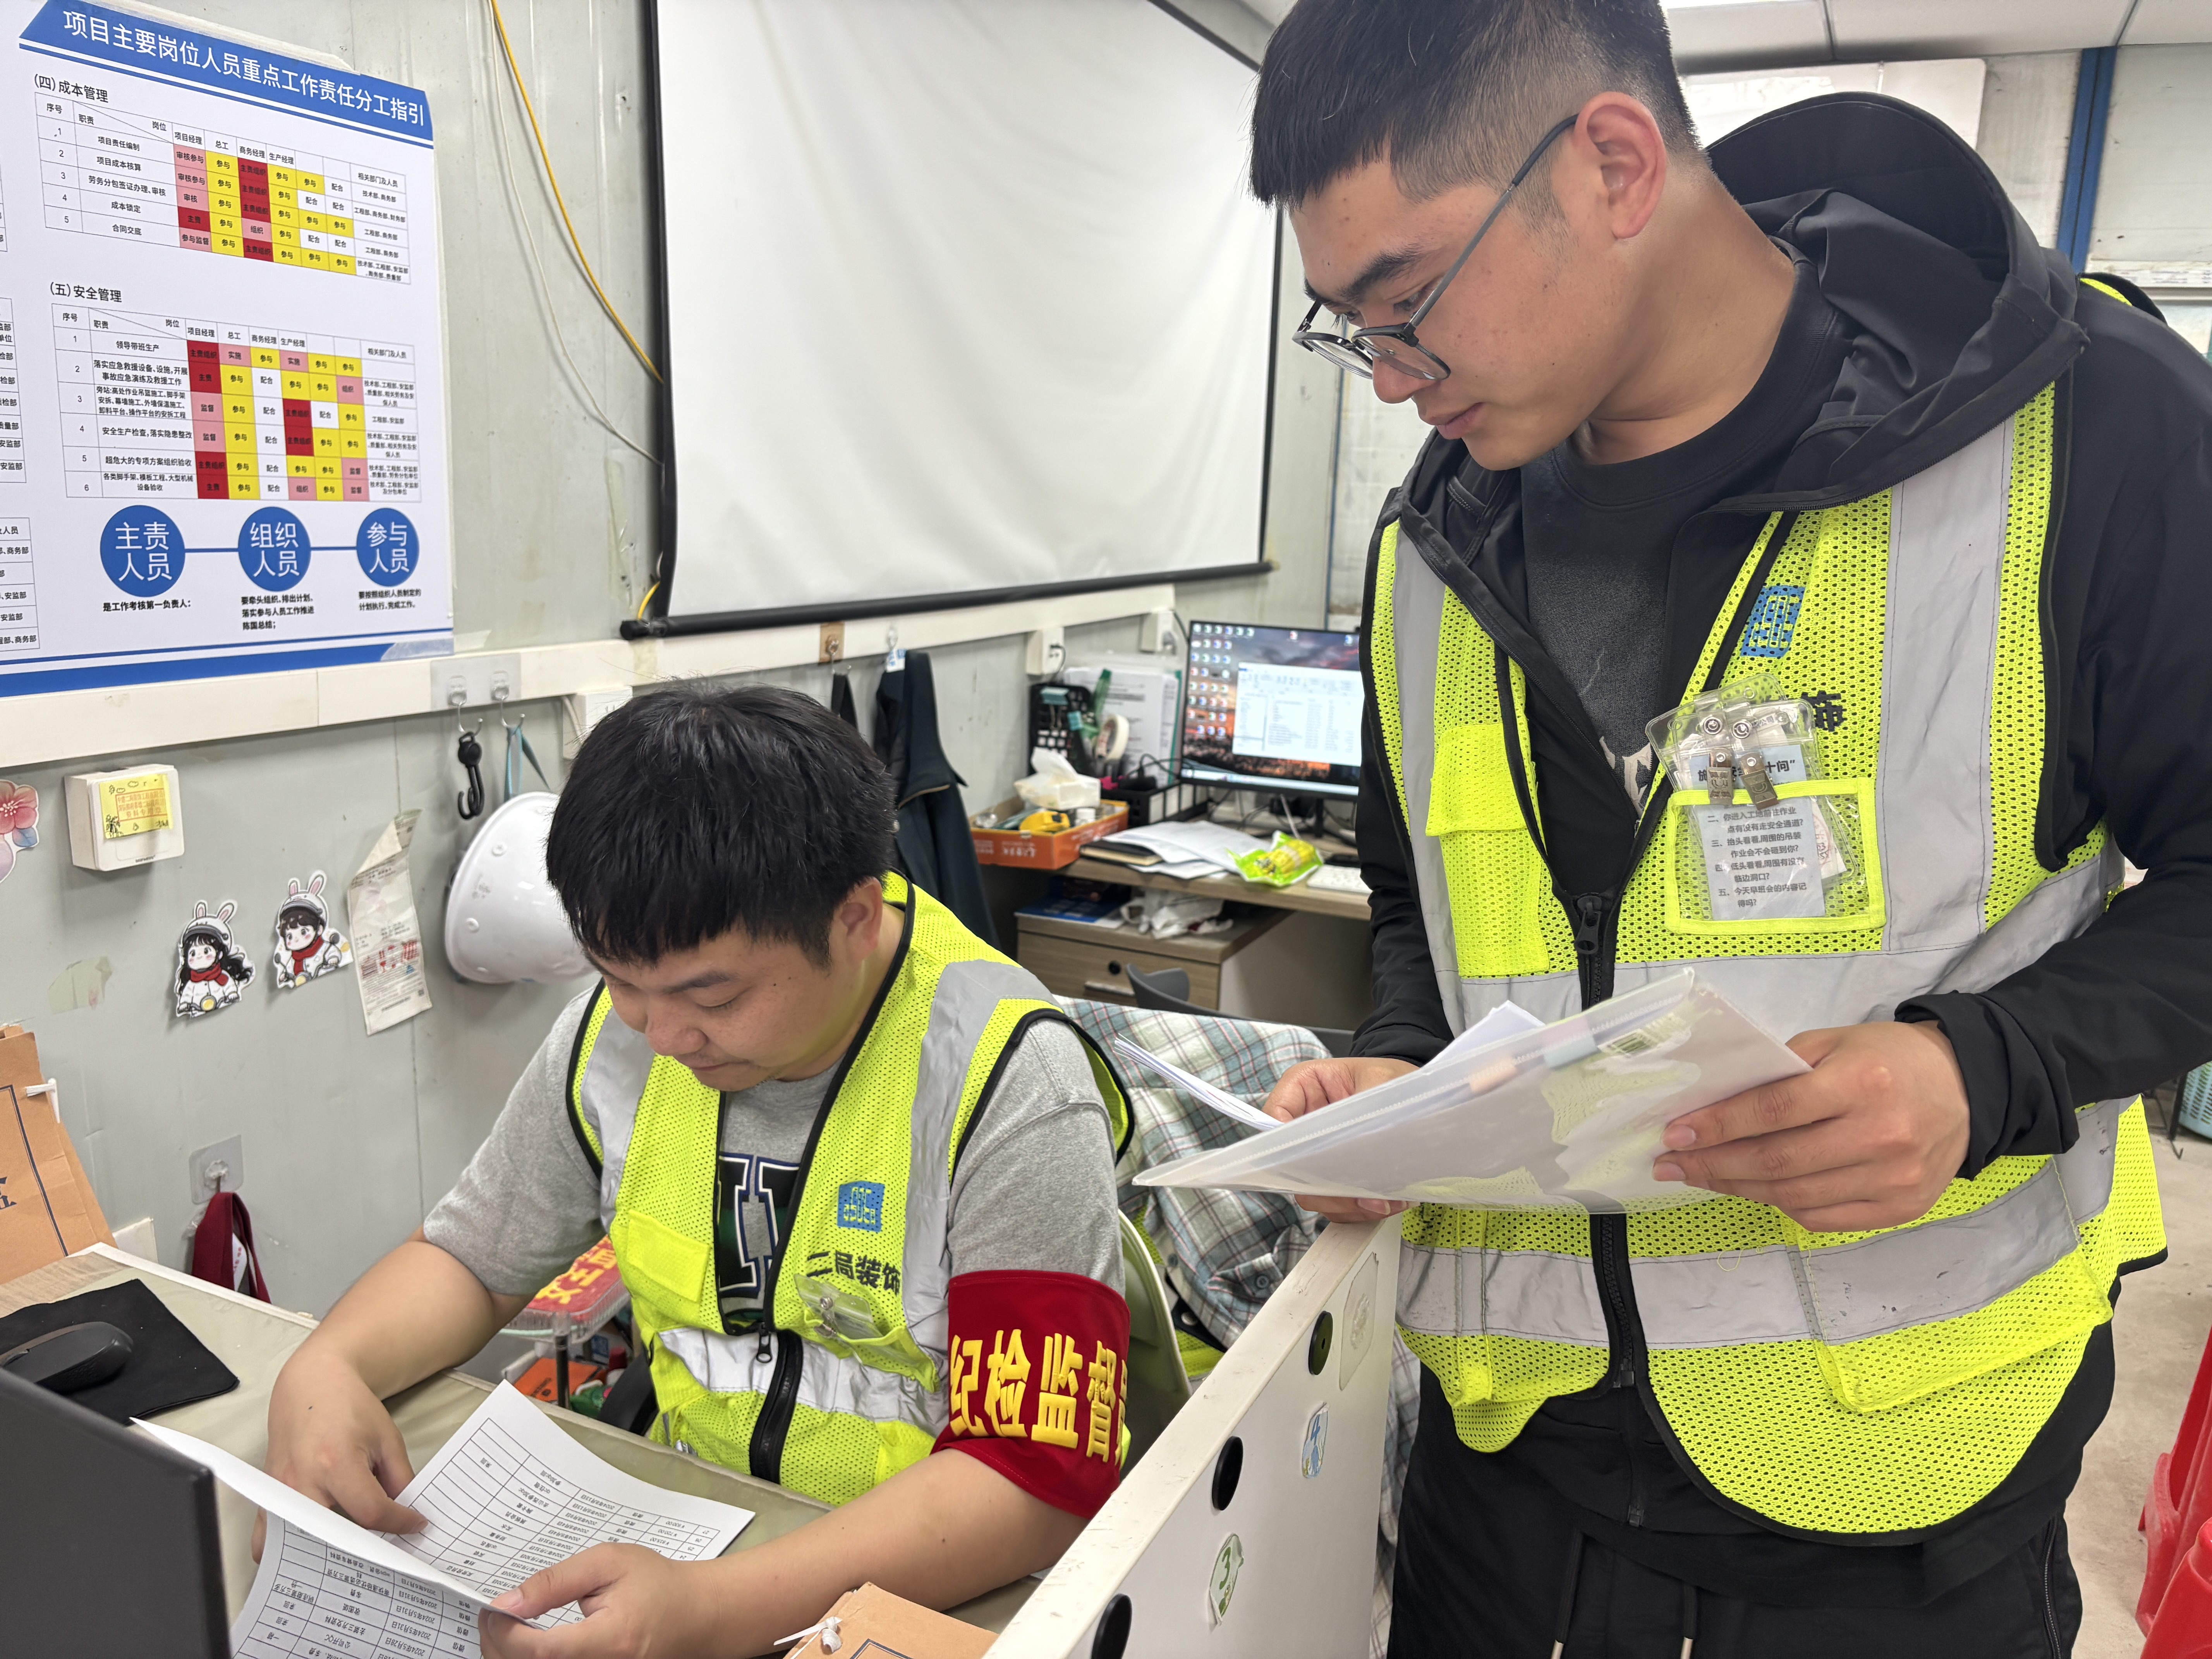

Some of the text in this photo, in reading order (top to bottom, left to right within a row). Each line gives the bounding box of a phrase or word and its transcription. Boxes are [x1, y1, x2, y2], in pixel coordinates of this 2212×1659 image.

[63, 10, 424, 126] 项目主要岗位人员重点工作责任分工指引
[46, 103, 62, 113] 序号
[79, 114, 94, 125] 职责
[152, 121, 167, 131] 岗位
[98, 136, 140, 151] 项目责任编制
[174, 132, 202, 144] 项目经理
[215, 141, 229, 149] 总工
[176, 152, 204, 163] 审核参与
[239, 146, 265, 159] 商务经理
[96, 156, 141, 171] 项目成本核算
[216, 160, 230, 169] 参与
[269, 153, 294, 165] 生产经理
[178, 173, 205, 185] 审核参与
[276, 172, 289, 181] 参与
[88, 175, 166, 196] 劳务分包签证办理、审核
[218, 179, 231, 188] 参与
[184, 194, 198, 203] 审核
[278, 191, 290, 199] 参与
[111, 201, 141, 213] 成本锁定
[218, 199, 231, 208] 参与
[278, 210, 291, 219] 参与
[220, 219, 233, 228] 参与
[112, 224, 142, 235] 合同交底
[280, 230, 292, 239] 参与
[182, 234, 209, 246] 参与监督
[222, 239, 235, 248] 参与
[282, 251, 294, 259] 参与
[63, 313, 77, 322] 序号
[93, 320, 109, 329] 职责
[165, 319, 180, 328] 岗位
[187, 327, 215, 337] 项目经理
[228, 331, 241, 340] 总工
[251, 335, 277, 345] 商务经理
[281, 338, 306, 348] 生产经理
[116, 341, 159, 352] 领导带班生产
[102, 372, 182, 386] 事故应急演练及救援工作
[105, 456, 192, 467] 超危大的专项方案组织验收
[115, 522, 169, 550] 主责
[250, 522, 299, 548] 组织
[367, 522, 407, 547] 参与
[118, 552, 172, 581] 人员
[253, 550, 300, 577] 人员
[369, 548, 410, 574] 人员
[807, 1249, 902, 1297] 二局装饰
[399, 1590, 437, 1609] 2024年5月31日
[396, 1605, 435, 1624] 2024年5月31日
[392, 1621, 431, 1640] 2024年5月31日
[385, 1637, 425, 1656] 2024年5月28日
